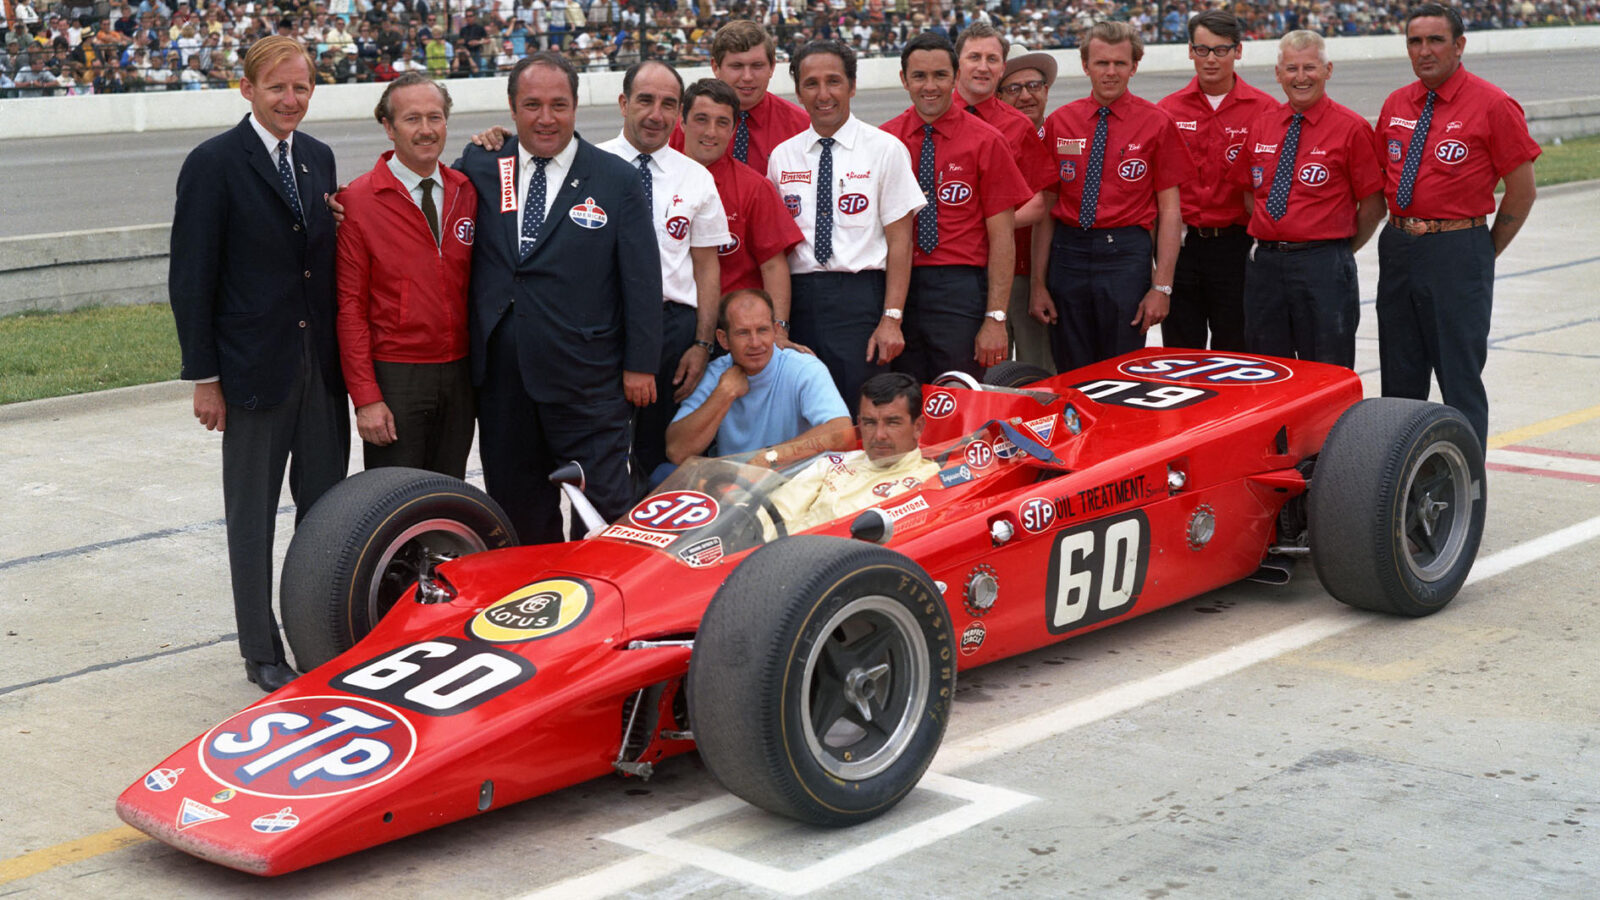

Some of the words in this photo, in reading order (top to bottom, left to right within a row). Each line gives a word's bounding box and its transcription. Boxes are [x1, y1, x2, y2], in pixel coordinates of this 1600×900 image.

[1438, 143, 1465, 161] STP
[1121, 161, 1145, 178] STP
[1300, 166, 1327, 183] STP
[501, 160, 513, 209] Firestone
[941, 184, 970, 202] STP
[839, 195, 867, 213] STP
[572, 211, 606, 222] AMERICAN
[1127, 357, 1279, 382] STP
[926, 394, 953, 415] STP
[968, 443, 991, 465] STP
[634, 495, 711, 526] STP
[1023, 499, 1053, 530] STP
[1054, 498, 1075, 520] OIL
[1080, 475, 1146, 514] TREATMENT
[607, 526, 670, 545] Firestone
[1053, 518, 1140, 628] 60
[490, 606, 549, 628] LOTUS
[963, 629, 985, 640] PERFECT
[963, 635, 983, 645] CIRCLE
[342, 641, 523, 710] 60
[210, 706, 395, 788] STP
